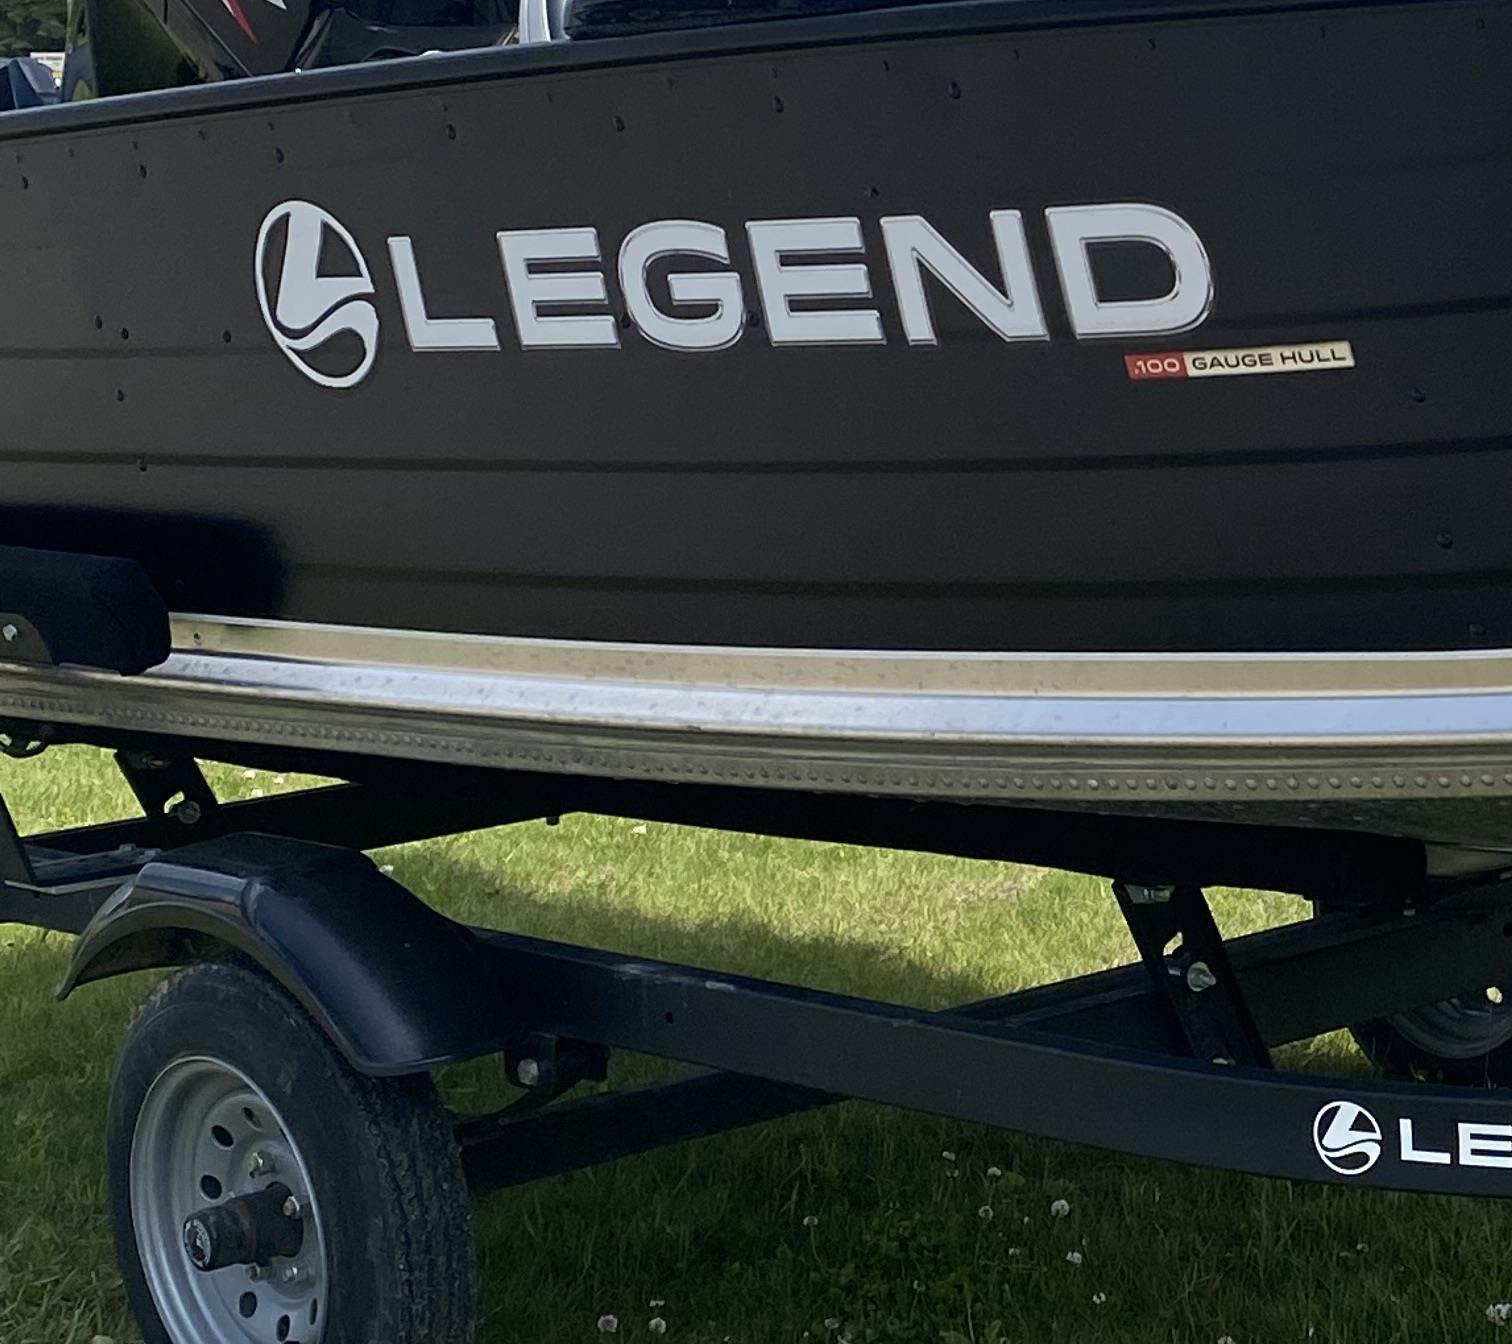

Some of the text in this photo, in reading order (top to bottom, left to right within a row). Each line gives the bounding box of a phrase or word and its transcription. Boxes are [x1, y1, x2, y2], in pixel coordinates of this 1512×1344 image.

[387, 202, 1214, 352] LEGEND
[1134, 348, 1347, 375] .100 GAUGE HULL
